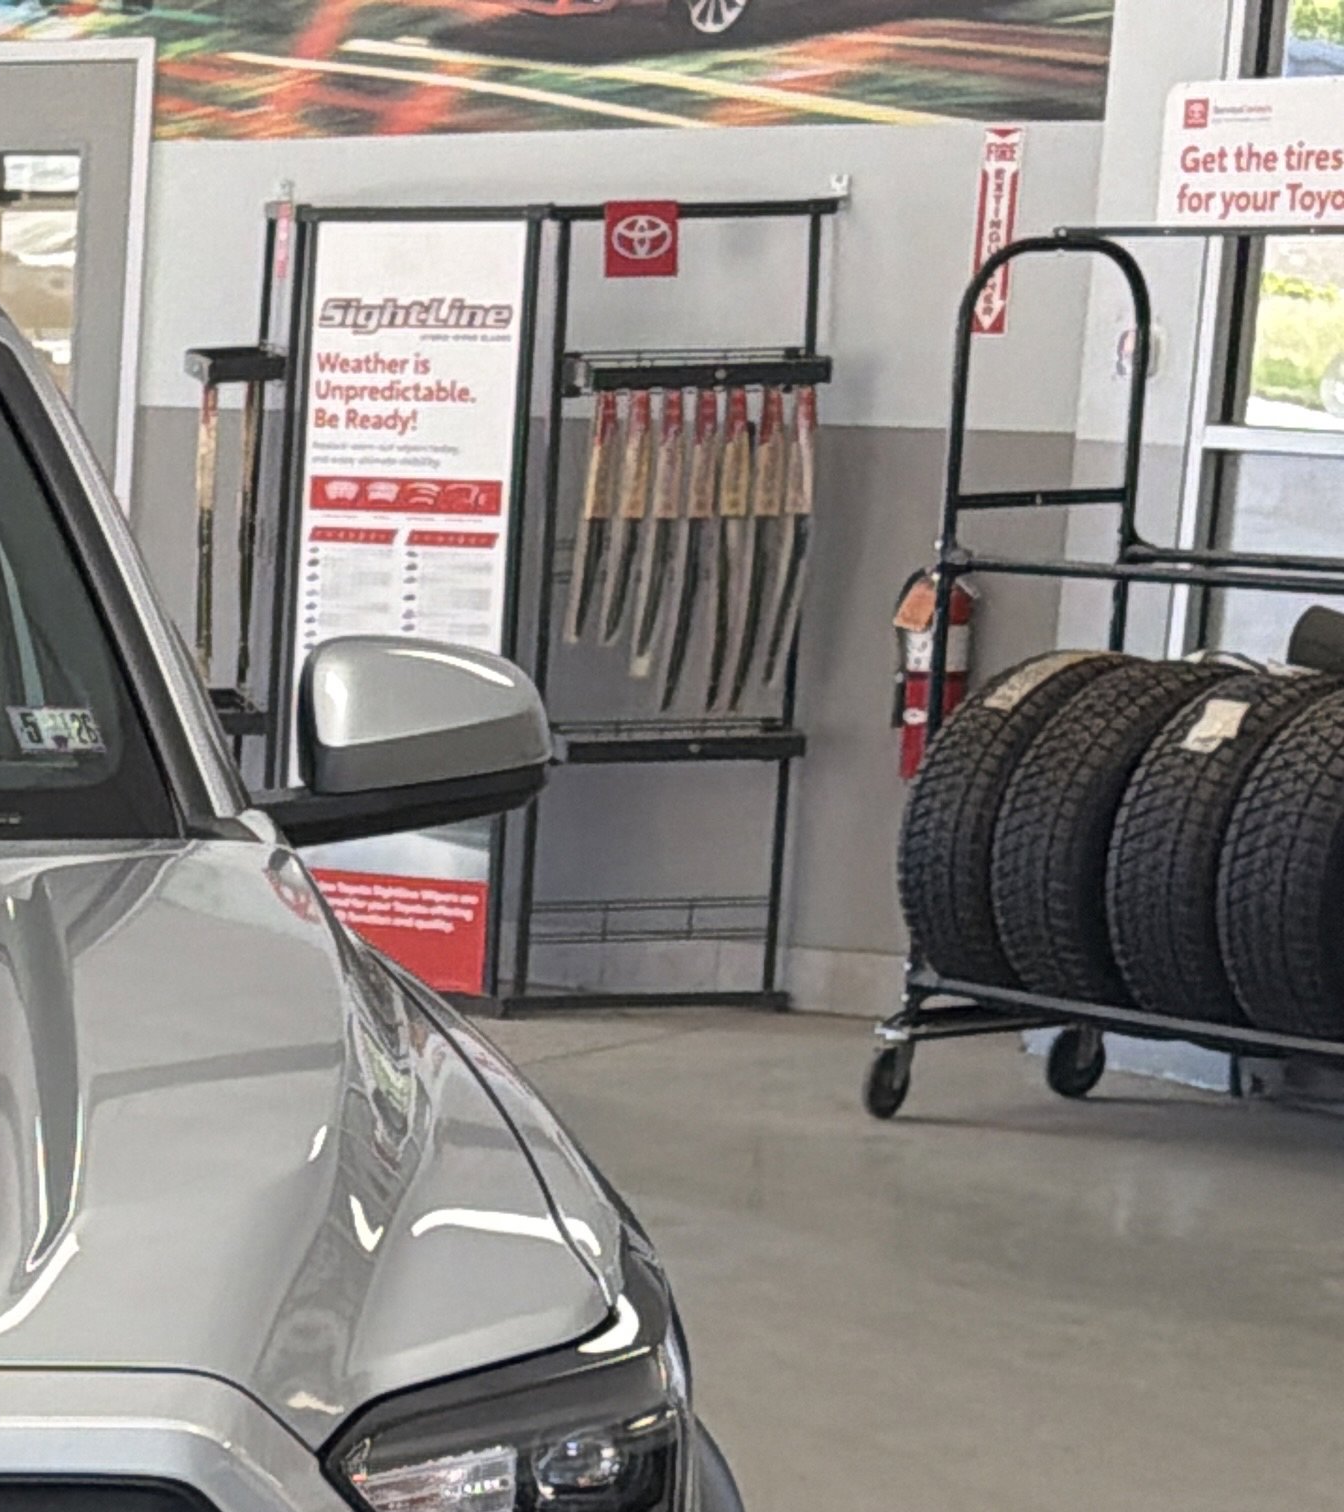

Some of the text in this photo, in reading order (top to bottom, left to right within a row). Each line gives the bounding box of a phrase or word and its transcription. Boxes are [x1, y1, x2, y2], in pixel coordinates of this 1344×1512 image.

[986, 142, 1019, 162] FIRE
[1180, 145, 1228, 173] Get
[1234, 142, 1279, 172] the
[1177, 183, 1216, 213] for
[1220, 190, 1281, 220] your
[316, 352, 431, 375] Weather is
[315, 379, 477, 405] Unpredictable.
[314, 408, 418, 436] Be Ready!
[20, 712, 44, 744] 5
